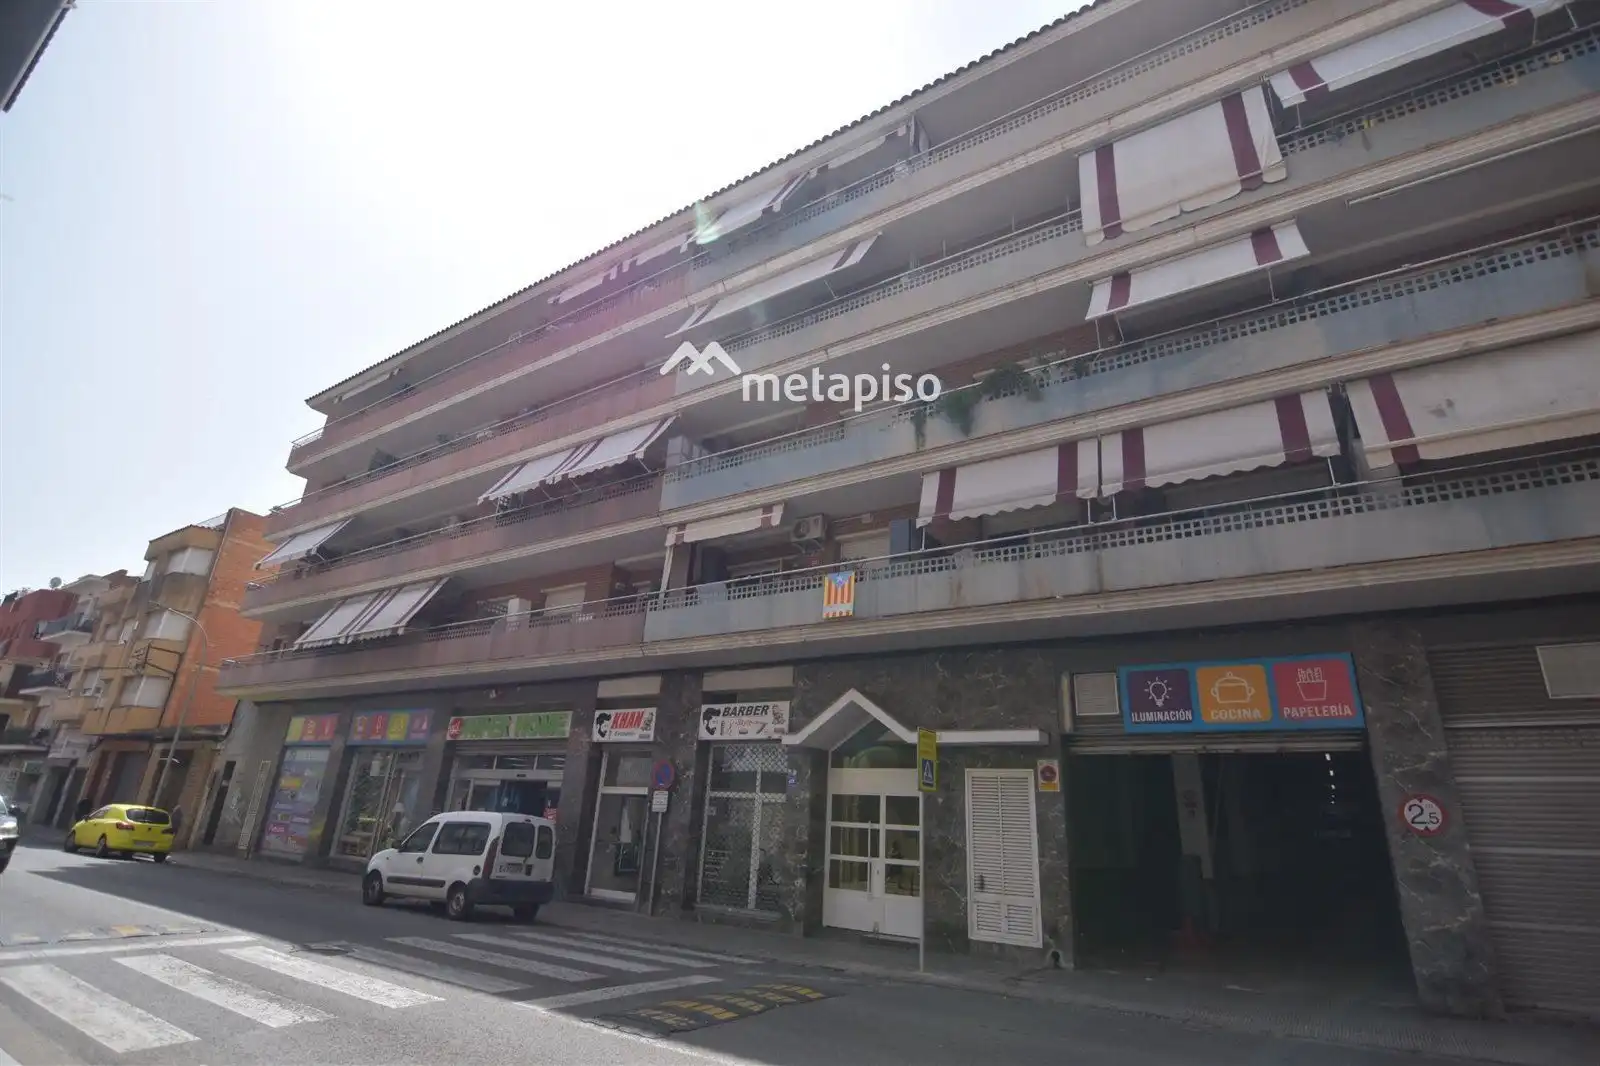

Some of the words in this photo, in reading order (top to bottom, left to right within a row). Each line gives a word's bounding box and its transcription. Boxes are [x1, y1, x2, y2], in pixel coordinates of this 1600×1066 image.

[722, 704, 770, 717] BARBER
[1131, 708, 1193, 722] ILUMINACIÓN
[1210, 707, 1262, 720] COCINA
[1283, 702, 1353, 718] PAPELERÍA
